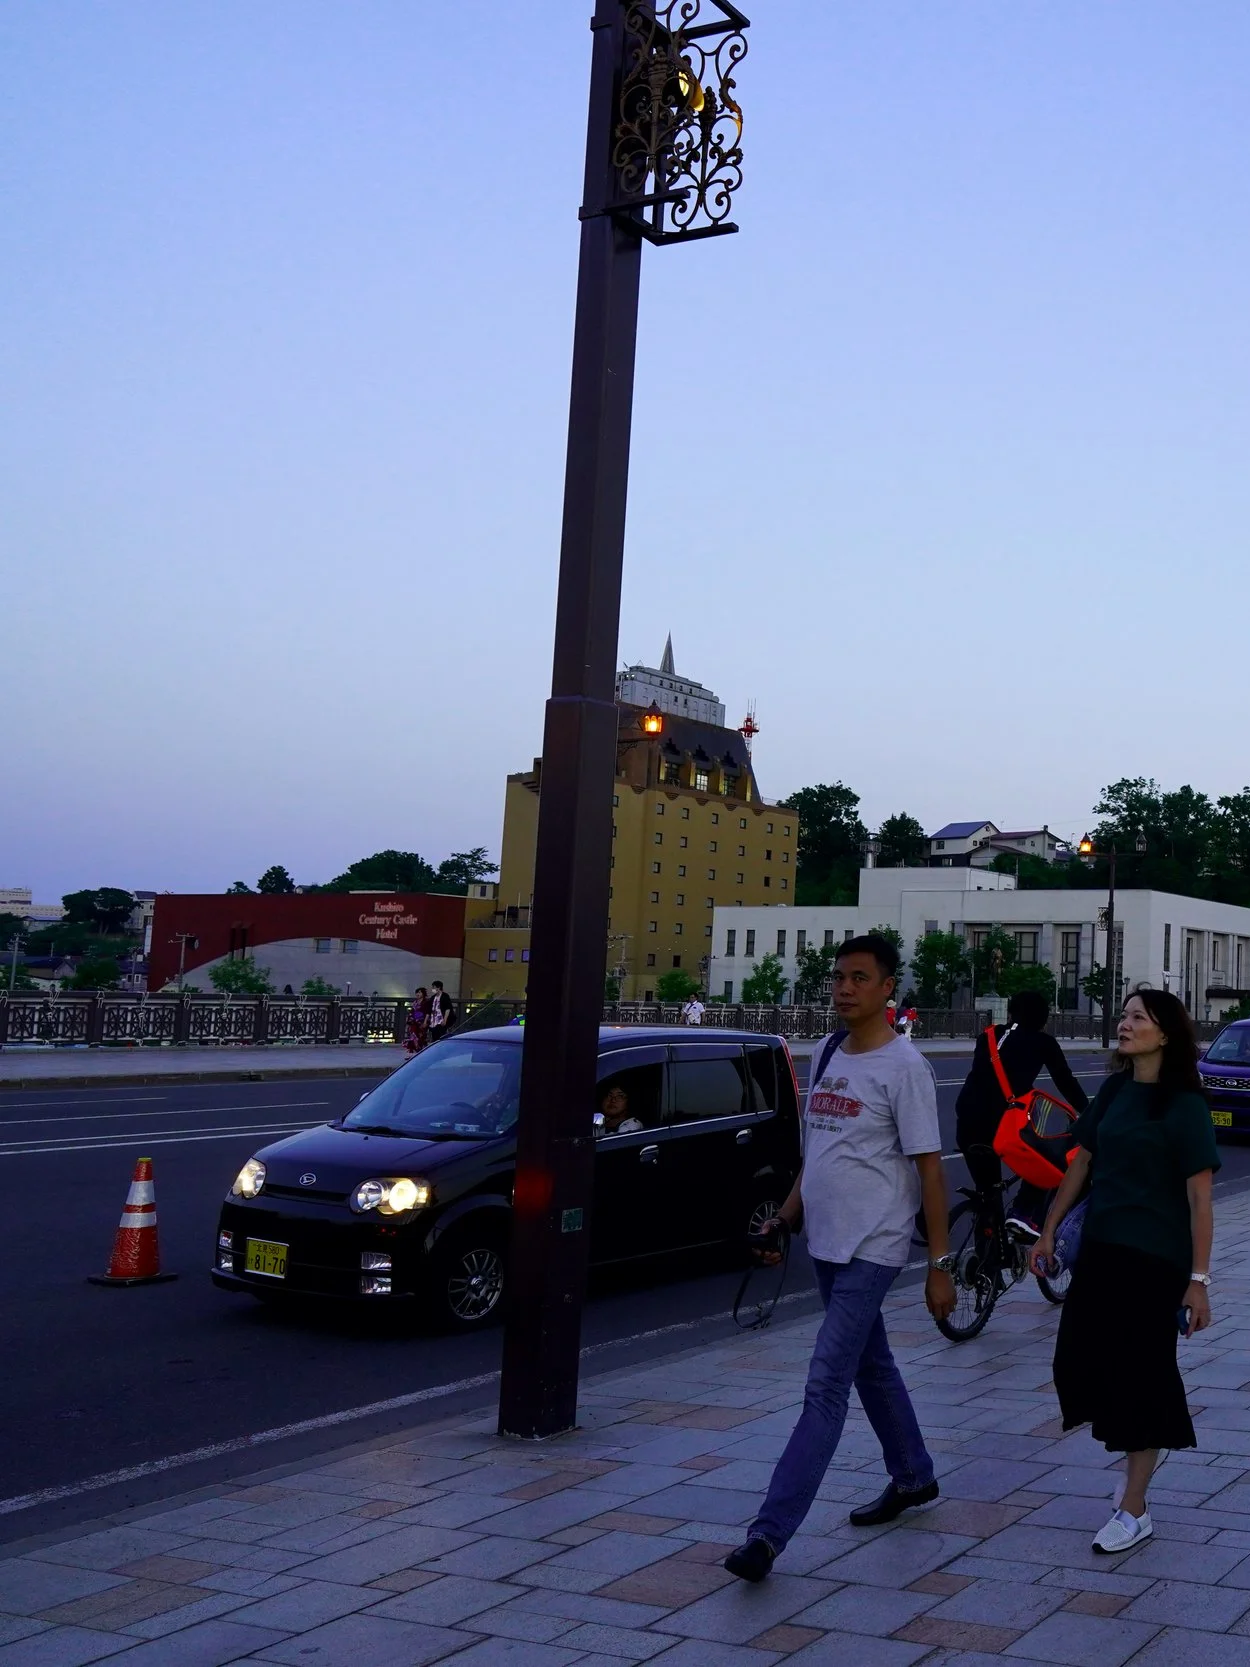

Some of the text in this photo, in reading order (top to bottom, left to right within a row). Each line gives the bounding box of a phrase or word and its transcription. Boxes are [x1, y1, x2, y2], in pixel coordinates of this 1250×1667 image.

[374, 902, 405, 913] Kushiro
[358, 913, 418, 927] Century Castle
[376, 928, 399, 940] Hotel
[811, 1095, 851, 1114] MORALE
[254, 1254, 285, 1274] 81-70
